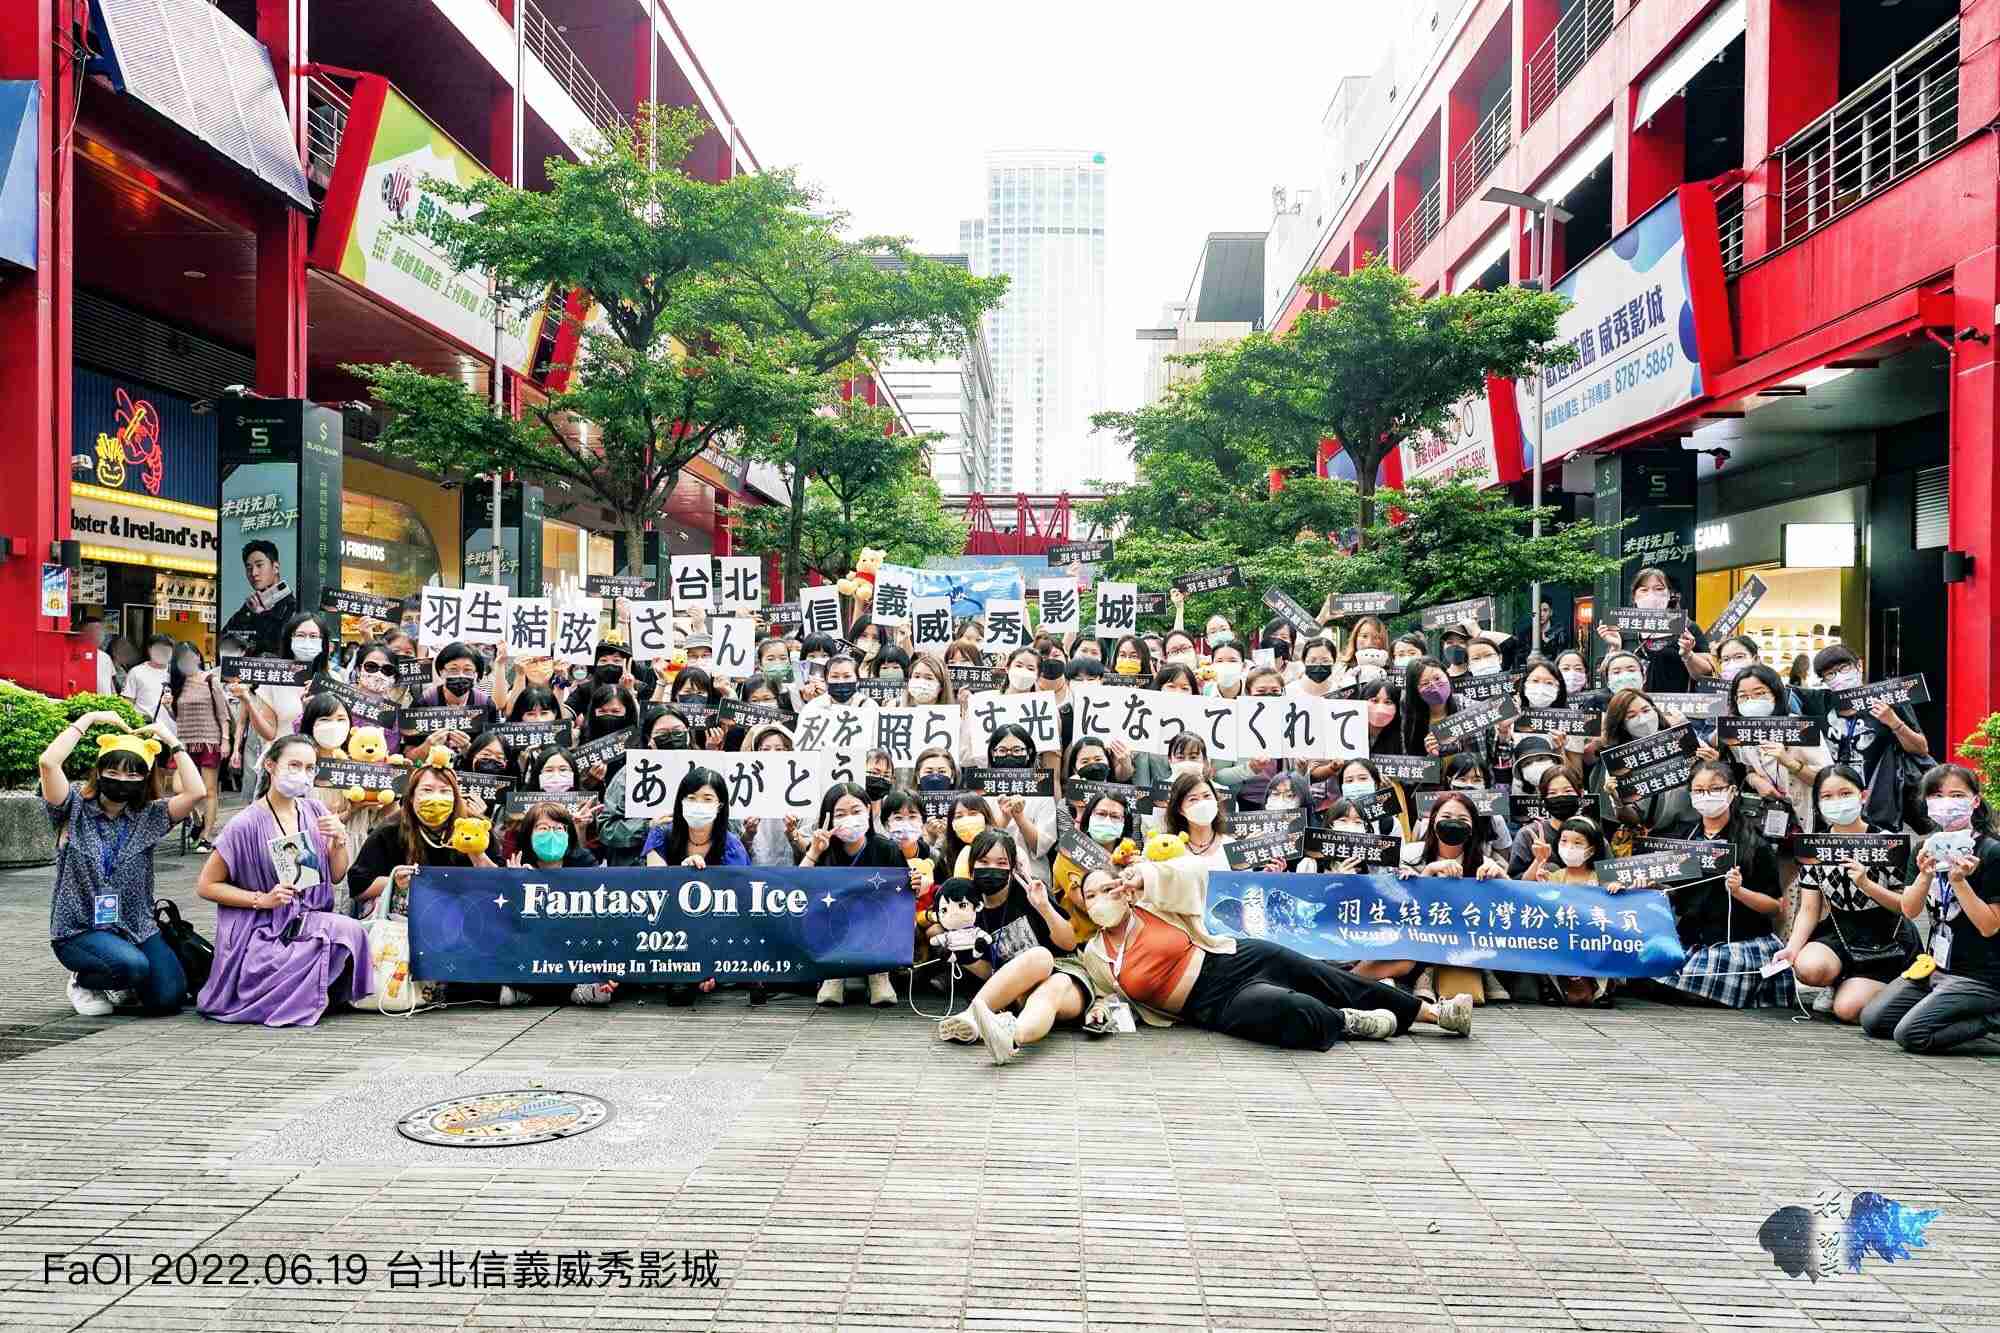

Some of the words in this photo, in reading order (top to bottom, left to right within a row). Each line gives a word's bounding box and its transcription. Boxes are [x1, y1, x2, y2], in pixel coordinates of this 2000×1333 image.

[1599, 286, 1667, 356] 威秀影城
[1615, 342, 1675, 394] 8787-5869
[251, 428, 269, 447] 5
[110, 516, 120, 535] &
[122, 518, 198, 547] Ireland's
[346, 541, 385, 562] FRIENDS
[676, 566, 710, 600] 台
[724, 567, 759, 601] 北
[336, 599, 388, 618] 羽生結弦
[805, 598, 838, 633] 信
[876, 583, 908, 618] 義
[916, 609, 951, 644] 威
[986, 611, 1022, 645] 秀
[1042, 588, 1076, 624] 影
[1099, 593, 1135, 629] 城
[511, 605, 549, 649] 結
[560, 611, 597, 656] 弦
[1618, 618, 1670, 631] 羽生結弦
[636, 607, 667, 650] さ
[716, 623, 747, 667] ん
[239, 668, 296, 683] 羽生結弦
[1464, 682, 1515, 699] 羽生結弦
[1840, 688, 1871, 700] FANTASY
[1851, 689, 1910, 711] 羽生結弦
[415, 718, 473, 732] 羽生結弦
[974, 698, 1055, 741] す光
[1448, 709, 1502, 737] 羽生結弦
[1530, 718, 1585, 733] 羽生結弦
[796, 710, 864, 752] 私を
[878, 710, 952, 761] 照ら
[1737, 728, 1801, 743] 羽生結弦
[1623, 740, 1683, 768] 羽生結弦
[330, 771, 393, 790] 羽生結弦
[632, 752, 854, 807] あがとう
[984, 780, 1039, 794] 羽生結弦
[1635, 768, 1690, 795] 羽生結弦
[1312, 832, 1345, 842] FANTASY
[1644, 841, 1678, 850] FANTASY
[1321, 843, 1383, 861] 羽生結弦
[1816, 847, 1889, 862] 羽生結弦
[1616, 863, 1682, 882] 羽生結弦
[520, 882, 669, 925] Fantasy
[678, 880, 739, 918] On
[748, 880, 809, 918] Ice
[1336, 898, 1643, 934] 羽生結弦台灣粉絲專頁
[635, 930, 690, 953] 2022
[1337, 926, 1399, 942] Yuzuru
[1408, 928, 1460, 947] Hanyu
[1470, 930, 1560, 952] Taiwanese
[1568, 933, 1645, 954] FanPage
[532, 960, 564, 974] Live
[567, 960, 628, 977] Viewing
[629, 960, 647, 974] In
[649, 960, 702, 974] Taiwan
[713, 959, 792, 975] 2022.06.19
